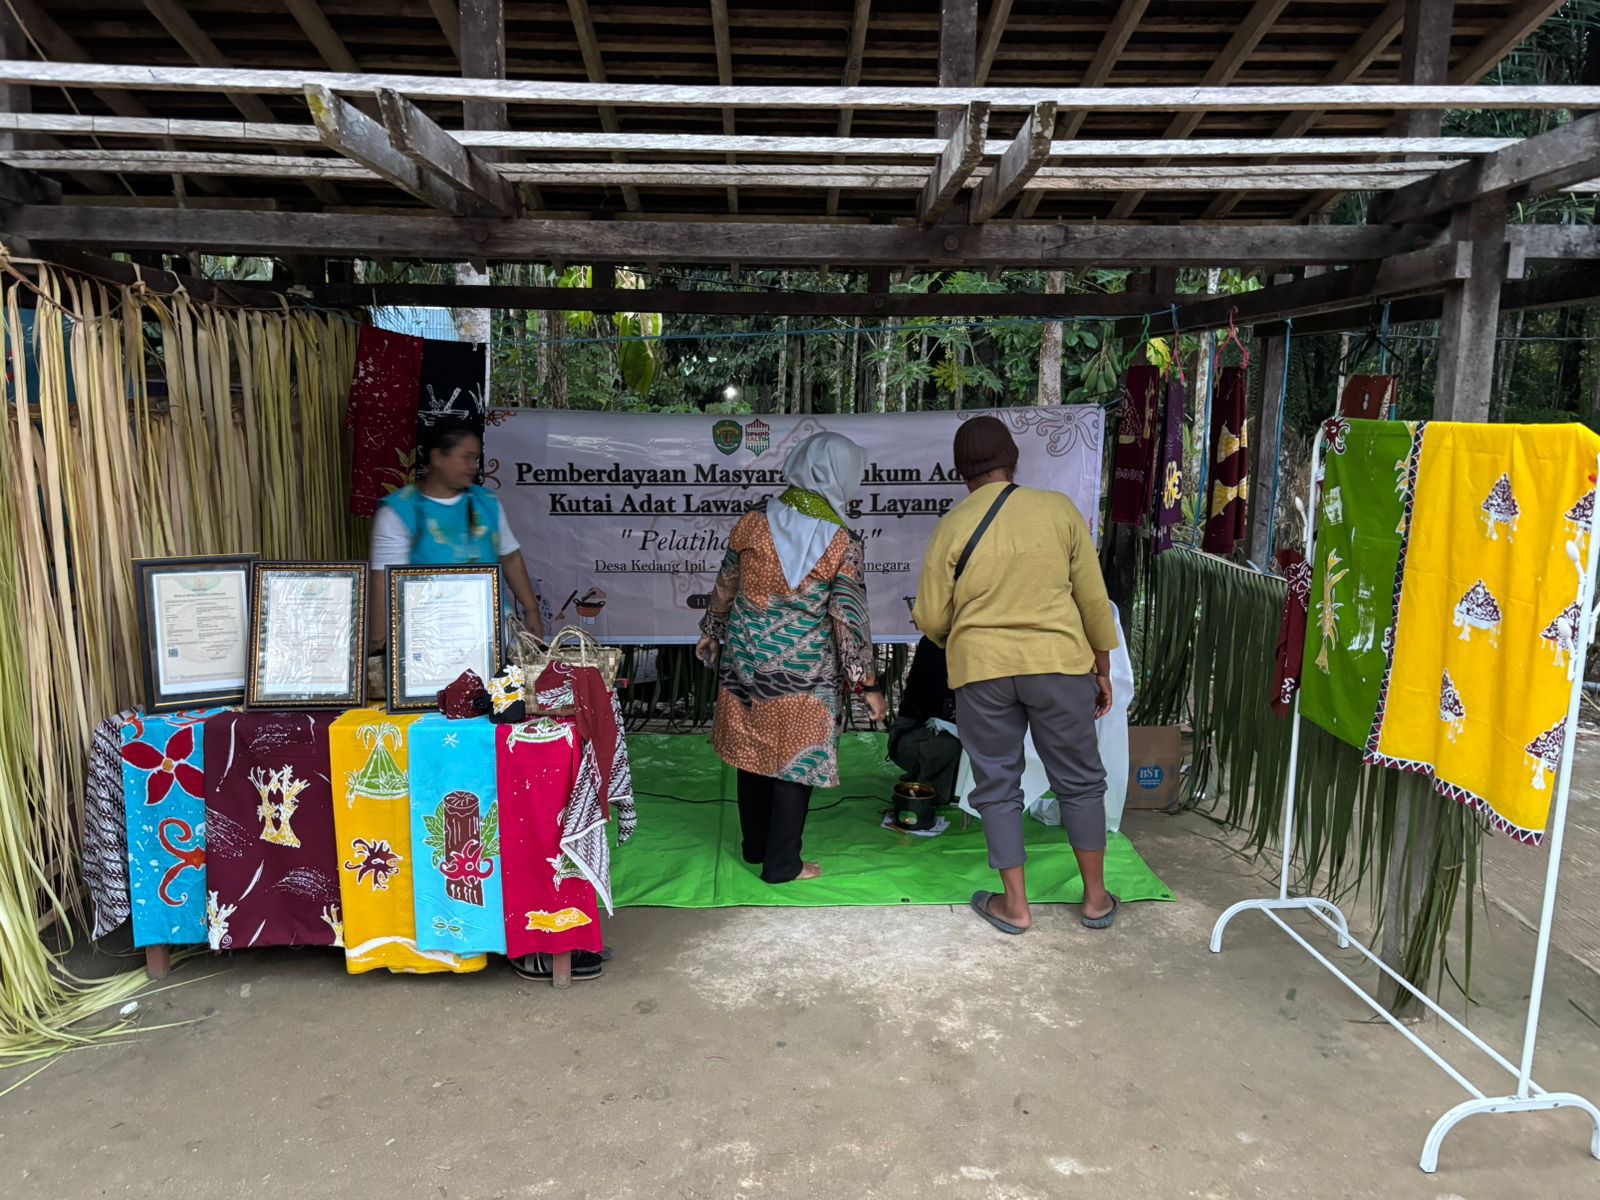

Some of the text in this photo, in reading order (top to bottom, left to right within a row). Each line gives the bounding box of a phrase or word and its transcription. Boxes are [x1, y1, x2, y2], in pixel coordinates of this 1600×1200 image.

[515, 462, 687, 489] Pemberdayaan
[693, 463, 787, 490] Masyara
[928, 462, 963, 482] Ad
[549, 493, 614, 513] Kutai
[620, 493, 677, 513] Adat
[683, 494, 753, 513] Lawas
[870, 493, 954, 519] Layang
[594, 560, 627, 571] Desa
[631, 560, 681, 575] Kedang
[685, 560, 706, 574] Ipil
